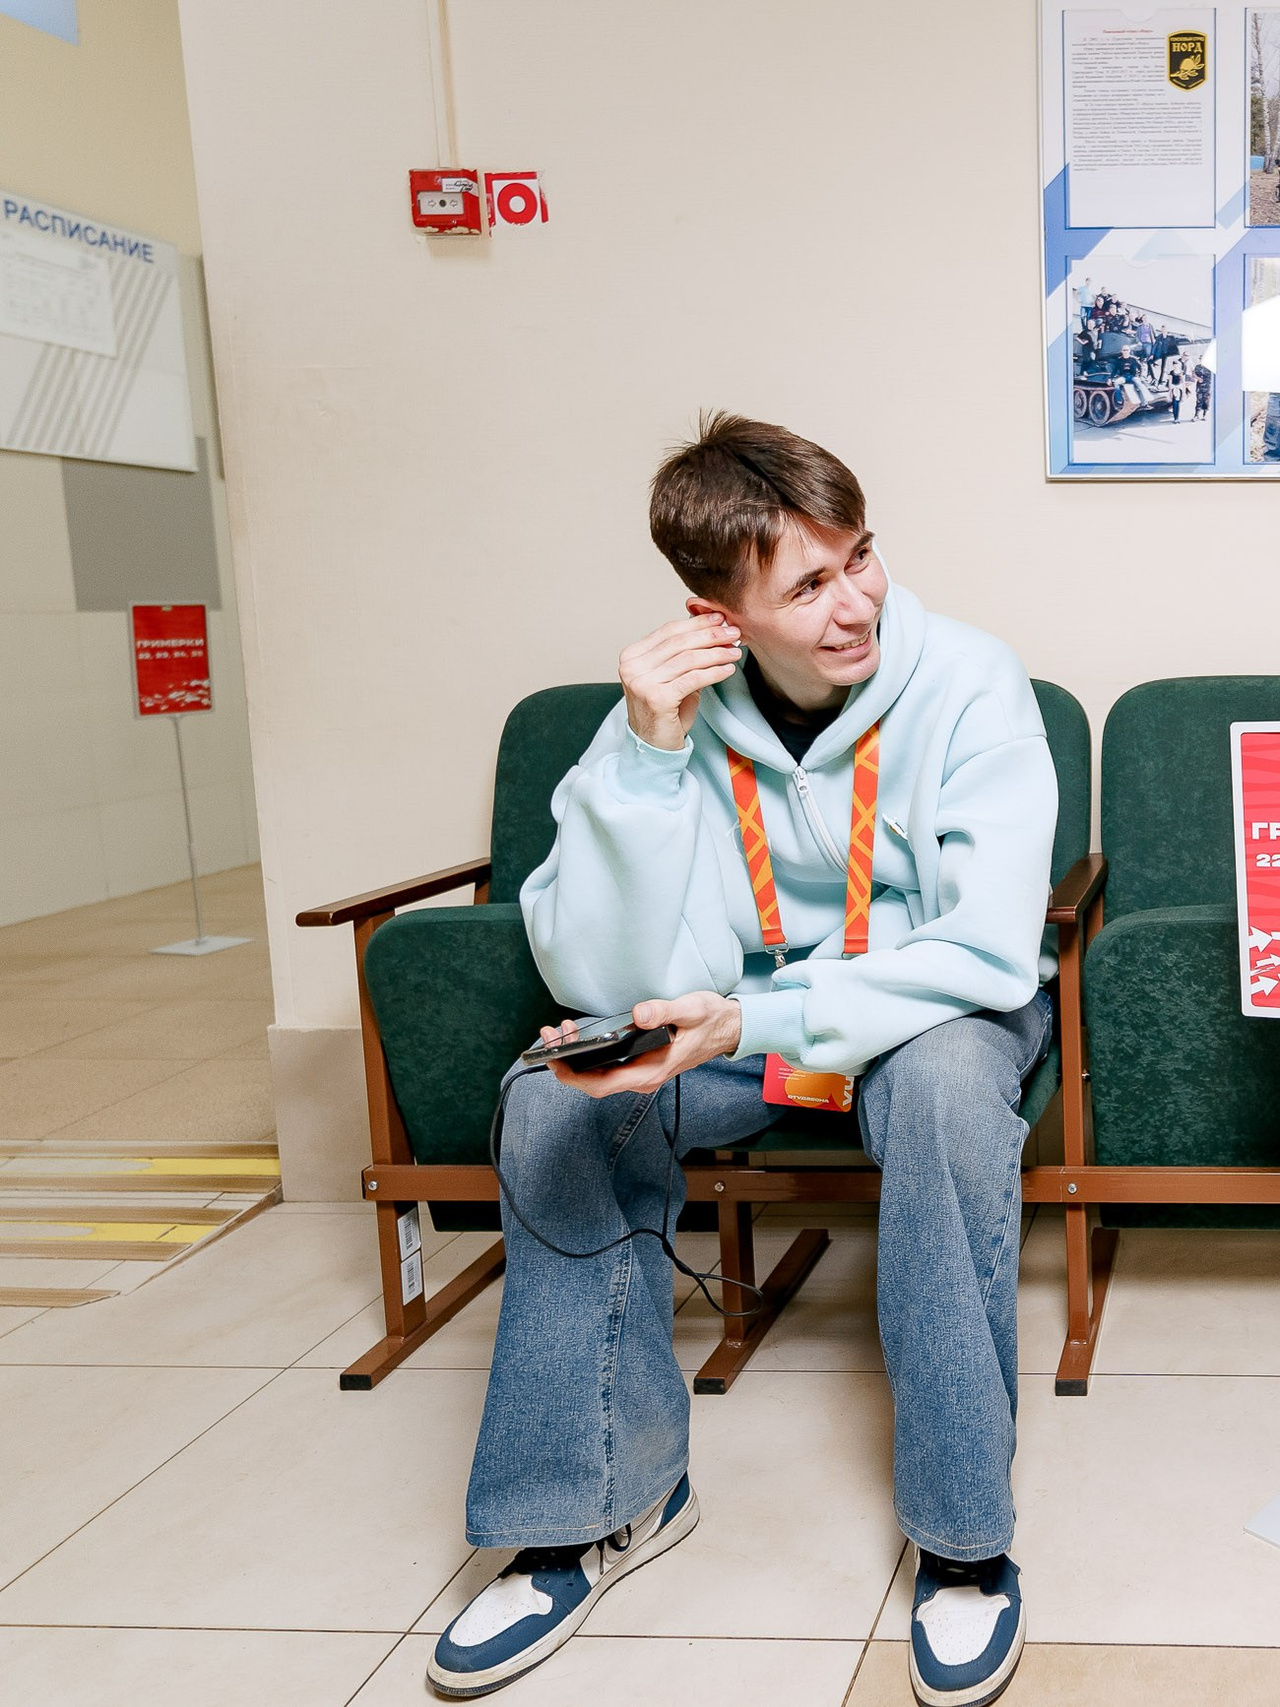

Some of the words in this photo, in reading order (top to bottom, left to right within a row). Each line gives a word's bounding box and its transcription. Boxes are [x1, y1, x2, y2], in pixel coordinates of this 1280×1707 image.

[1172, 42, 1203, 53] НОРД
[4, 200, 154, 263] РАСПИСАНИЕ
[137, 639, 204, 648] ГРИМЕРКИ
